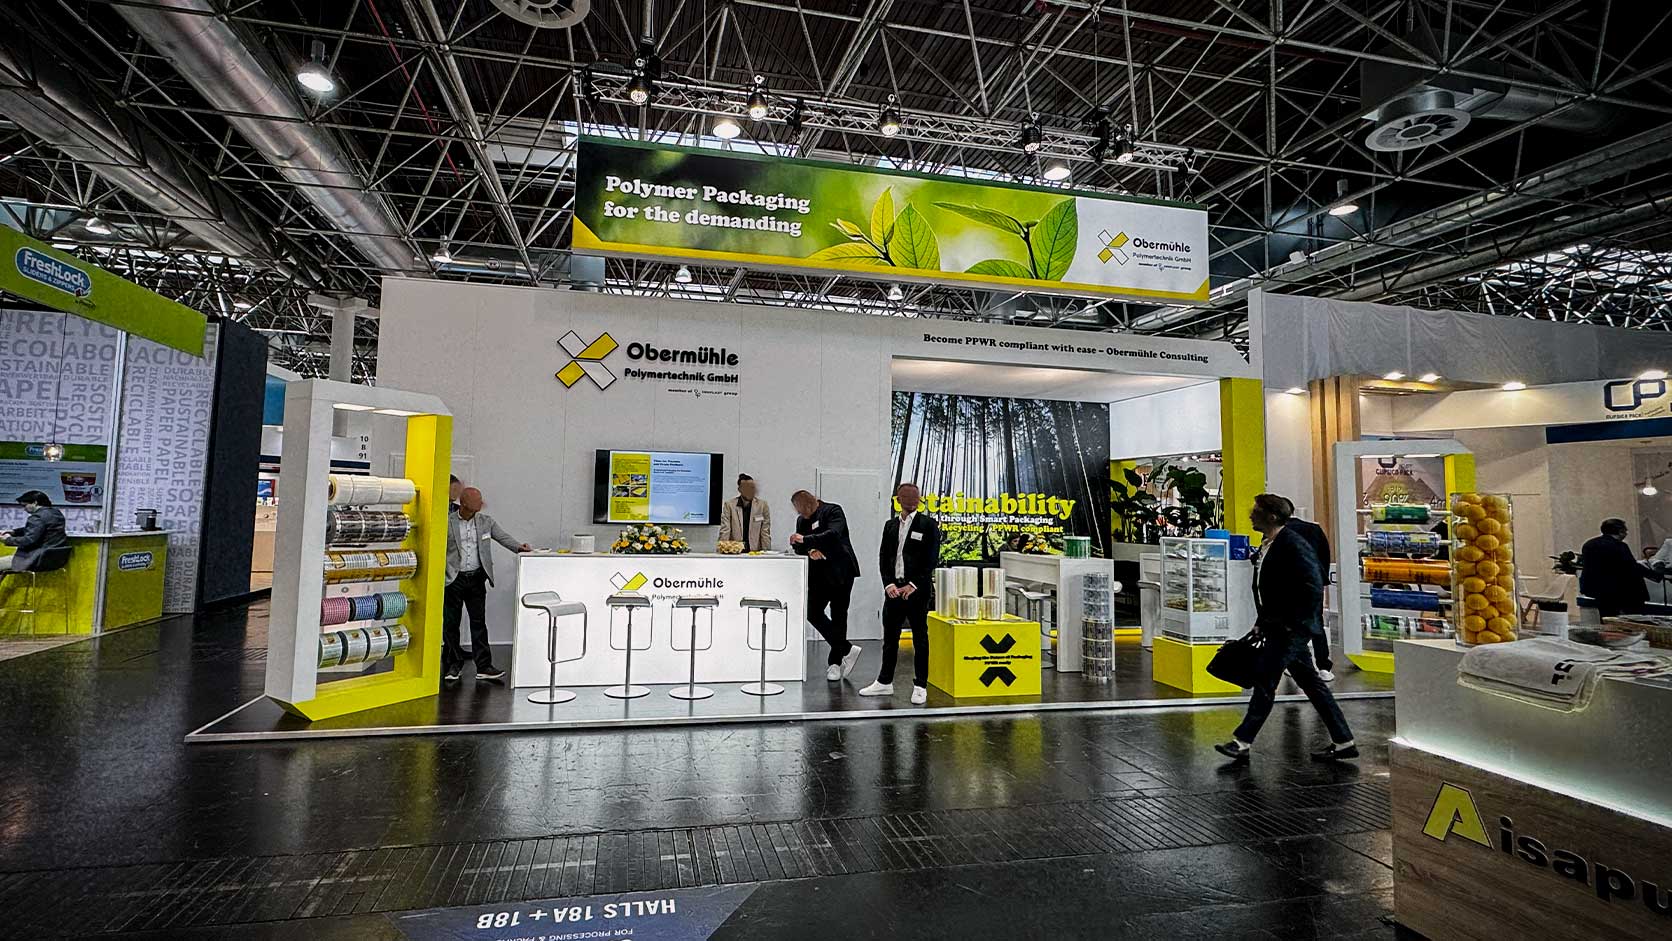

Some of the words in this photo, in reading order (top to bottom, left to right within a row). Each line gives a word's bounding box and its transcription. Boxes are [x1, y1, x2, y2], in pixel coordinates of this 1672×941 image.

[605, 175, 698, 200] Polymer
[702, 185, 811, 214] Packaging
[603, 201, 639, 219] for
[643, 204, 680, 223] the
[684, 209, 802, 237] demanding
[1132, 237, 1191, 253] Obermühle
[626, 342, 740, 366] Obermühle
[923, 333, 963, 345] Become
[965, 336, 997, 347] PPWR
[998, 341, 1049, 351] compliant
[1051, 343, 1075, 353] with
[1076, 346, 1097, 354] ease
[1106, 347, 1158, 359] Obermühle
[1159, 351, 1209, 364] Consulting
[624, 367, 706, 383] Polymertechnik
[706, 373, 739, 384] GmbH
[158, 388, 177, 433] PAPER
[171, 389, 193, 487] SUSTAINABLE
[188, 389, 210, 487] RECYCLABLE
[360, 435, 369, 443] 10
[154, 438, 172, 485] PAPEL
[358, 452, 367, 460] 91
[940, 515, 979, 524] through
[979, 515, 1009, 523] Smart
[1009, 515, 1054, 525] Packaging
[941, 524, 985, 534] Recycling
[991, 524, 1019, 532] PPWR
[1020, 525, 1064, 534] compliant
[652, 577, 725, 589] Obermühle
[528, 909, 548, 921] +
[553, 904, 594, 923] 18A
[603, 898, 677, 919] HALLS
[476, 910, 521, 930] 18B
[548, 929, 612, 941] PROCESSING
[614, 927, 634, 937] FOR
